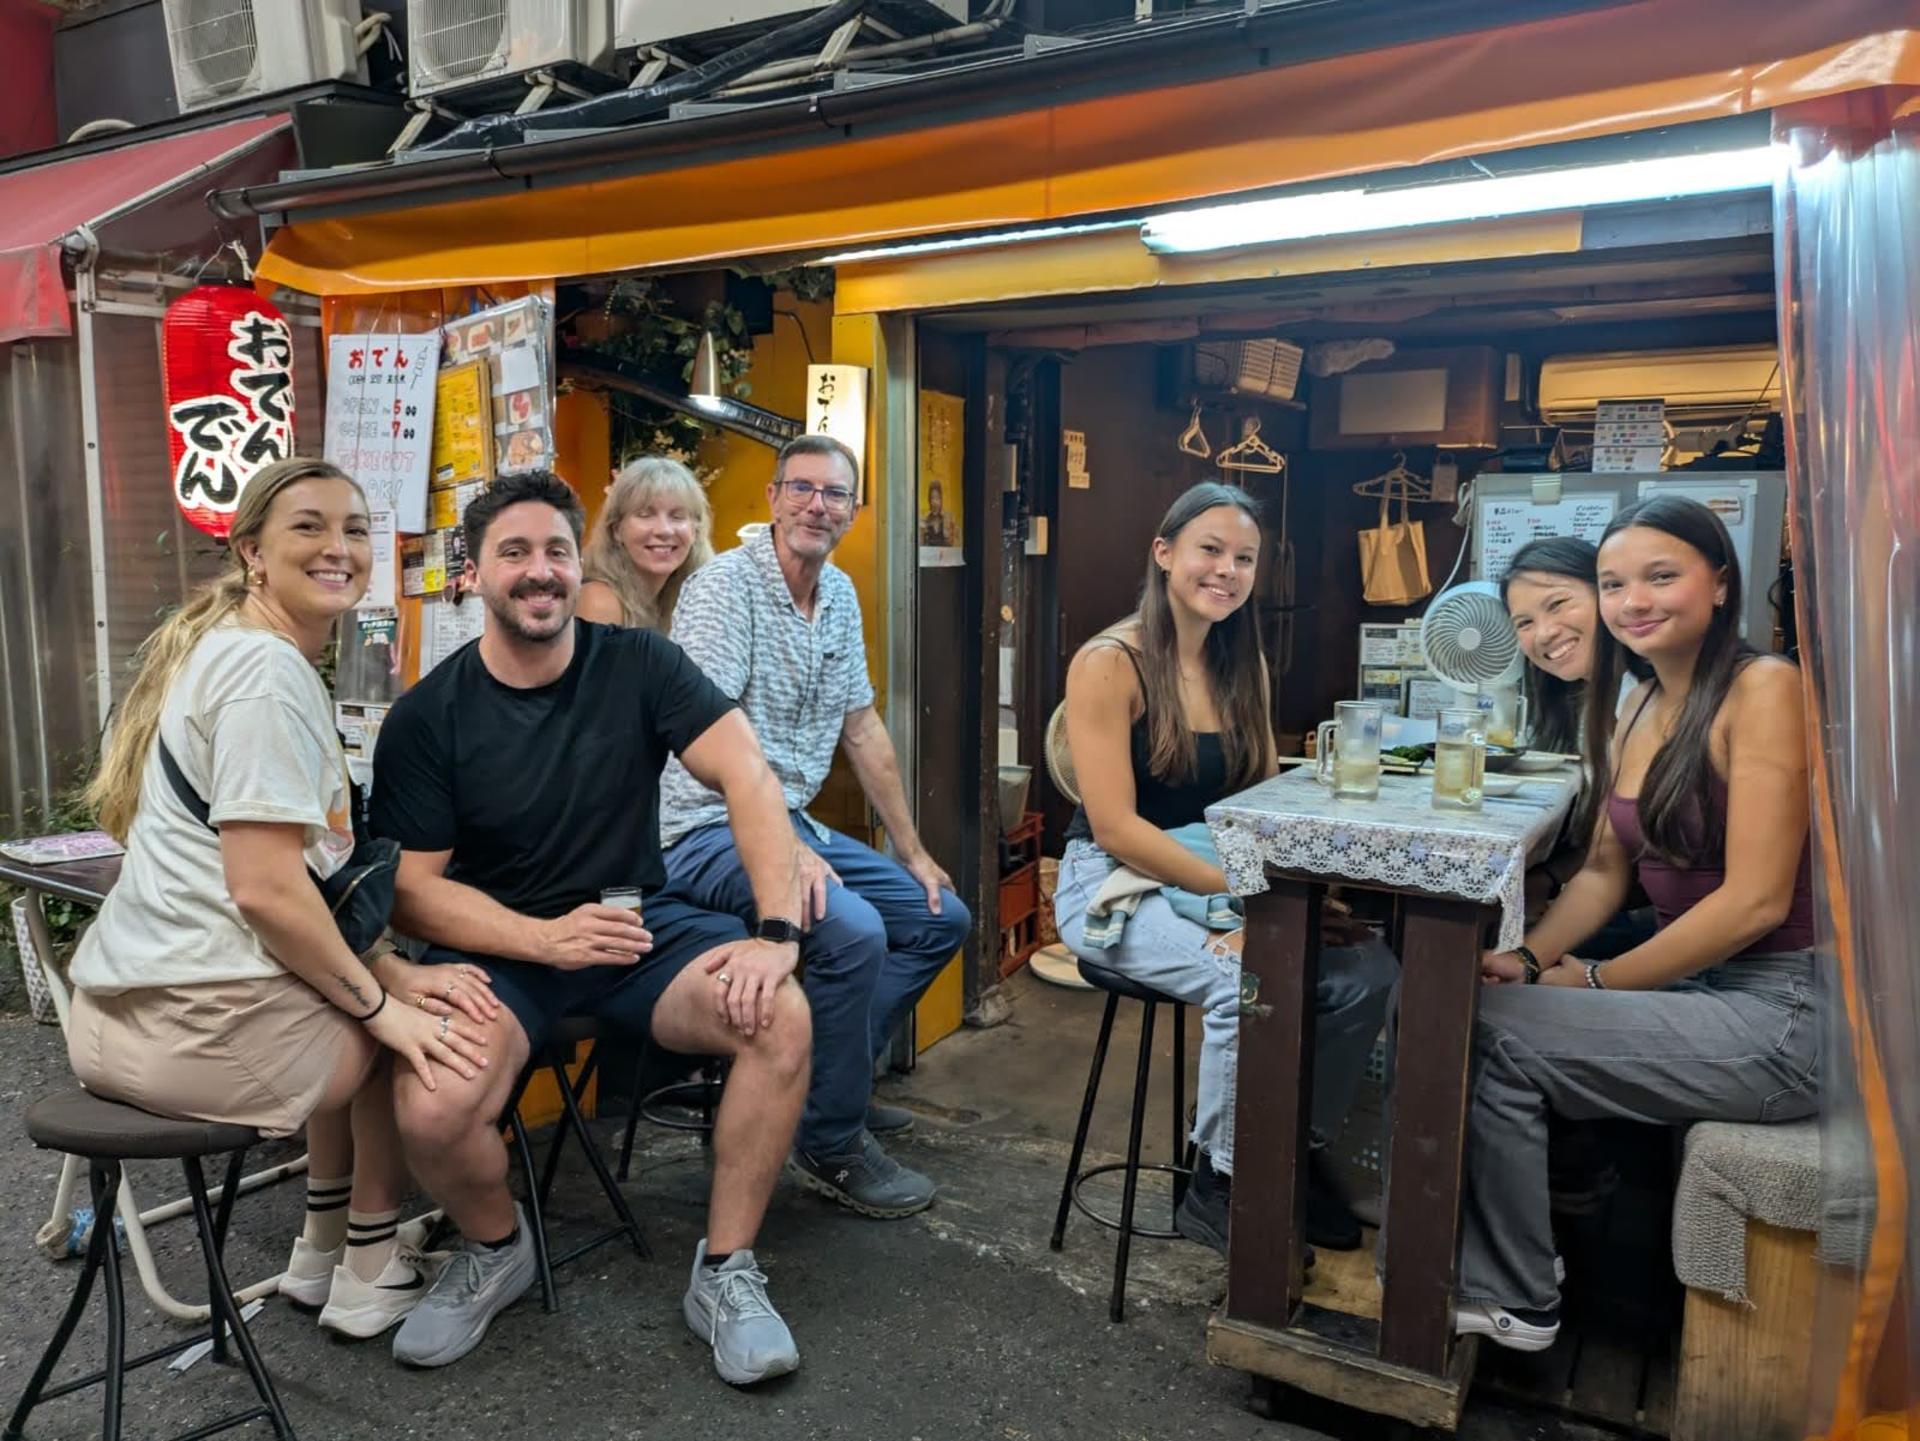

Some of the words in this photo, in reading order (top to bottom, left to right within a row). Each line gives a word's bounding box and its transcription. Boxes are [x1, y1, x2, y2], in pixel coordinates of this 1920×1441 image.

[348, 346, 408, 369] おでん
[233, 314, 293, 466] おでん
[392, 398, 402, 415] 5
[404, 404, 417, 417] 00
[817, 372, 836, 433] おでん
[172, 399, 248, 507] でん
[403, 427, 415, 440] 00
